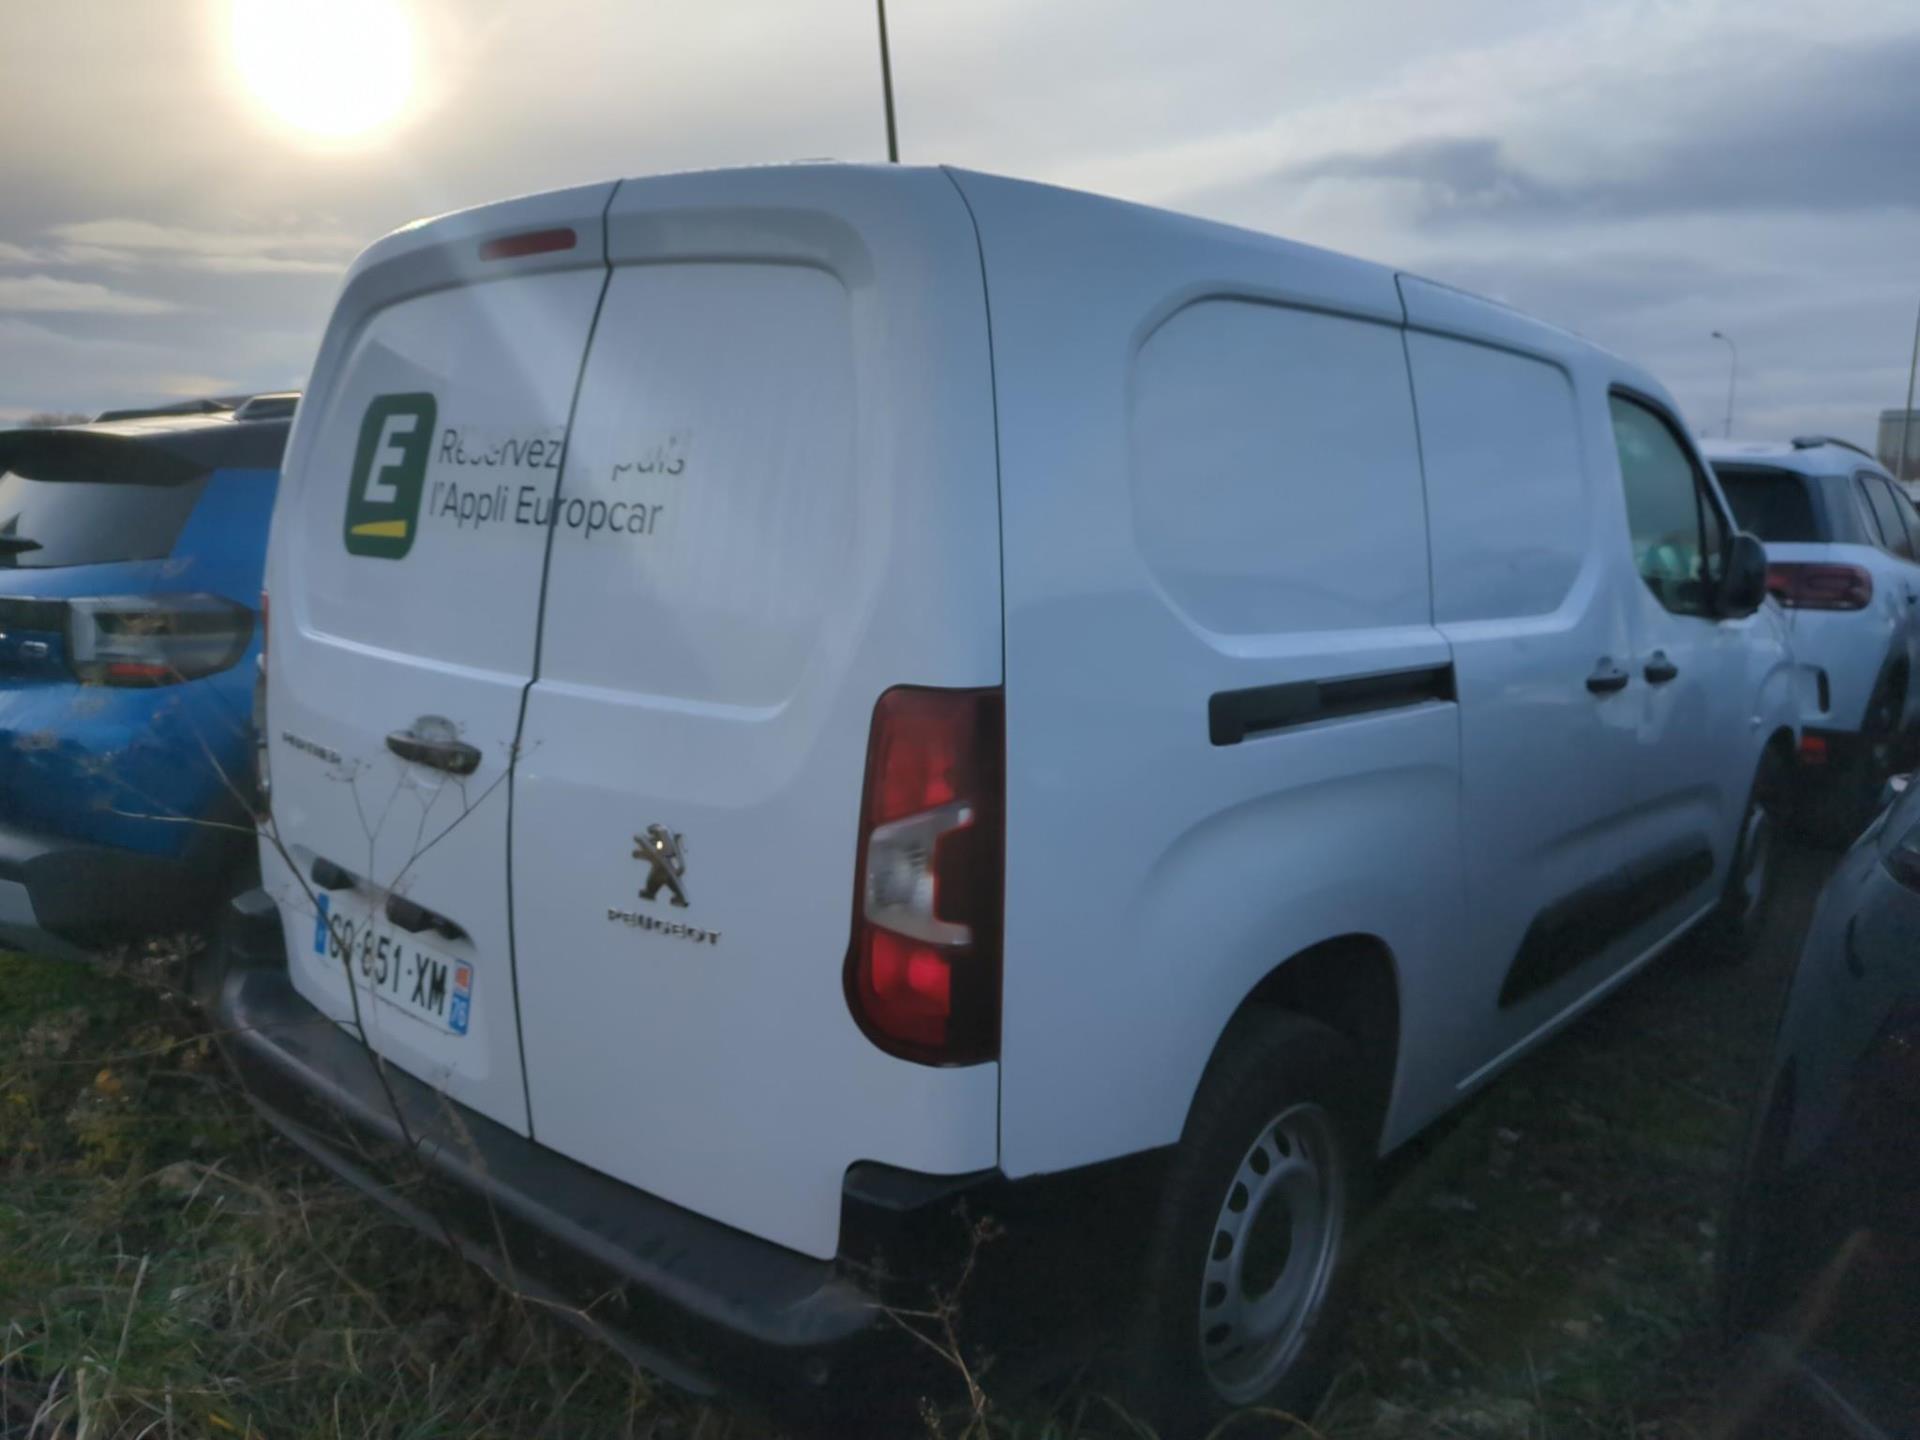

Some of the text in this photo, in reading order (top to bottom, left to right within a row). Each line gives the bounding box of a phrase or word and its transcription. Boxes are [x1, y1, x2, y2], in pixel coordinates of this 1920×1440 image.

[362, 412, 419, 504] E
[428, 481, 664, 540] l'Appli Europcar
